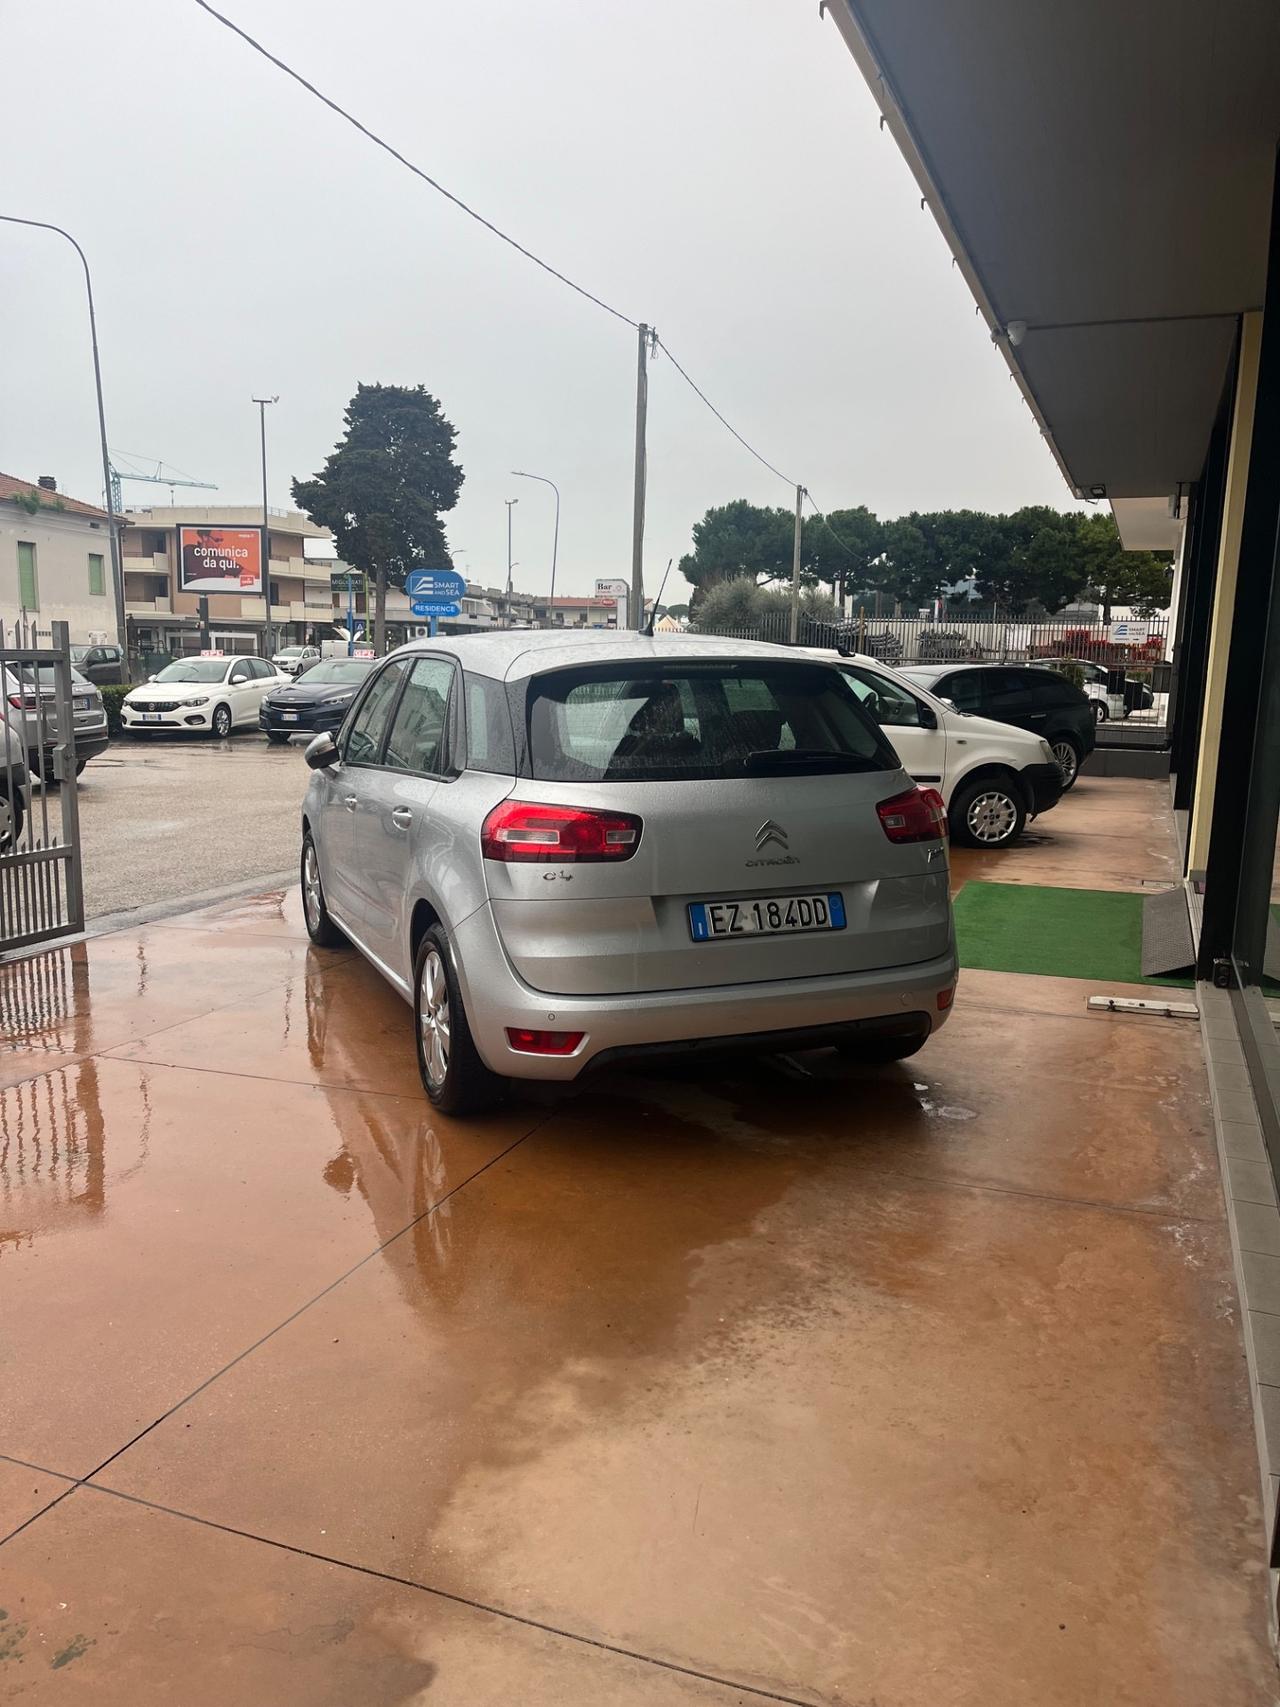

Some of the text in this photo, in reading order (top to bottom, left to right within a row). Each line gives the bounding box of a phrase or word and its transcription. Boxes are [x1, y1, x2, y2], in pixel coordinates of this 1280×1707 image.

[194, 547, 248, 557] comunica
[203, 557, 240, 571] da qui.
[415, 604, 456, 612] RESIDENCE
[709, 903, 743, 933] EZ
[753, 897, 829, 930] 184DD
